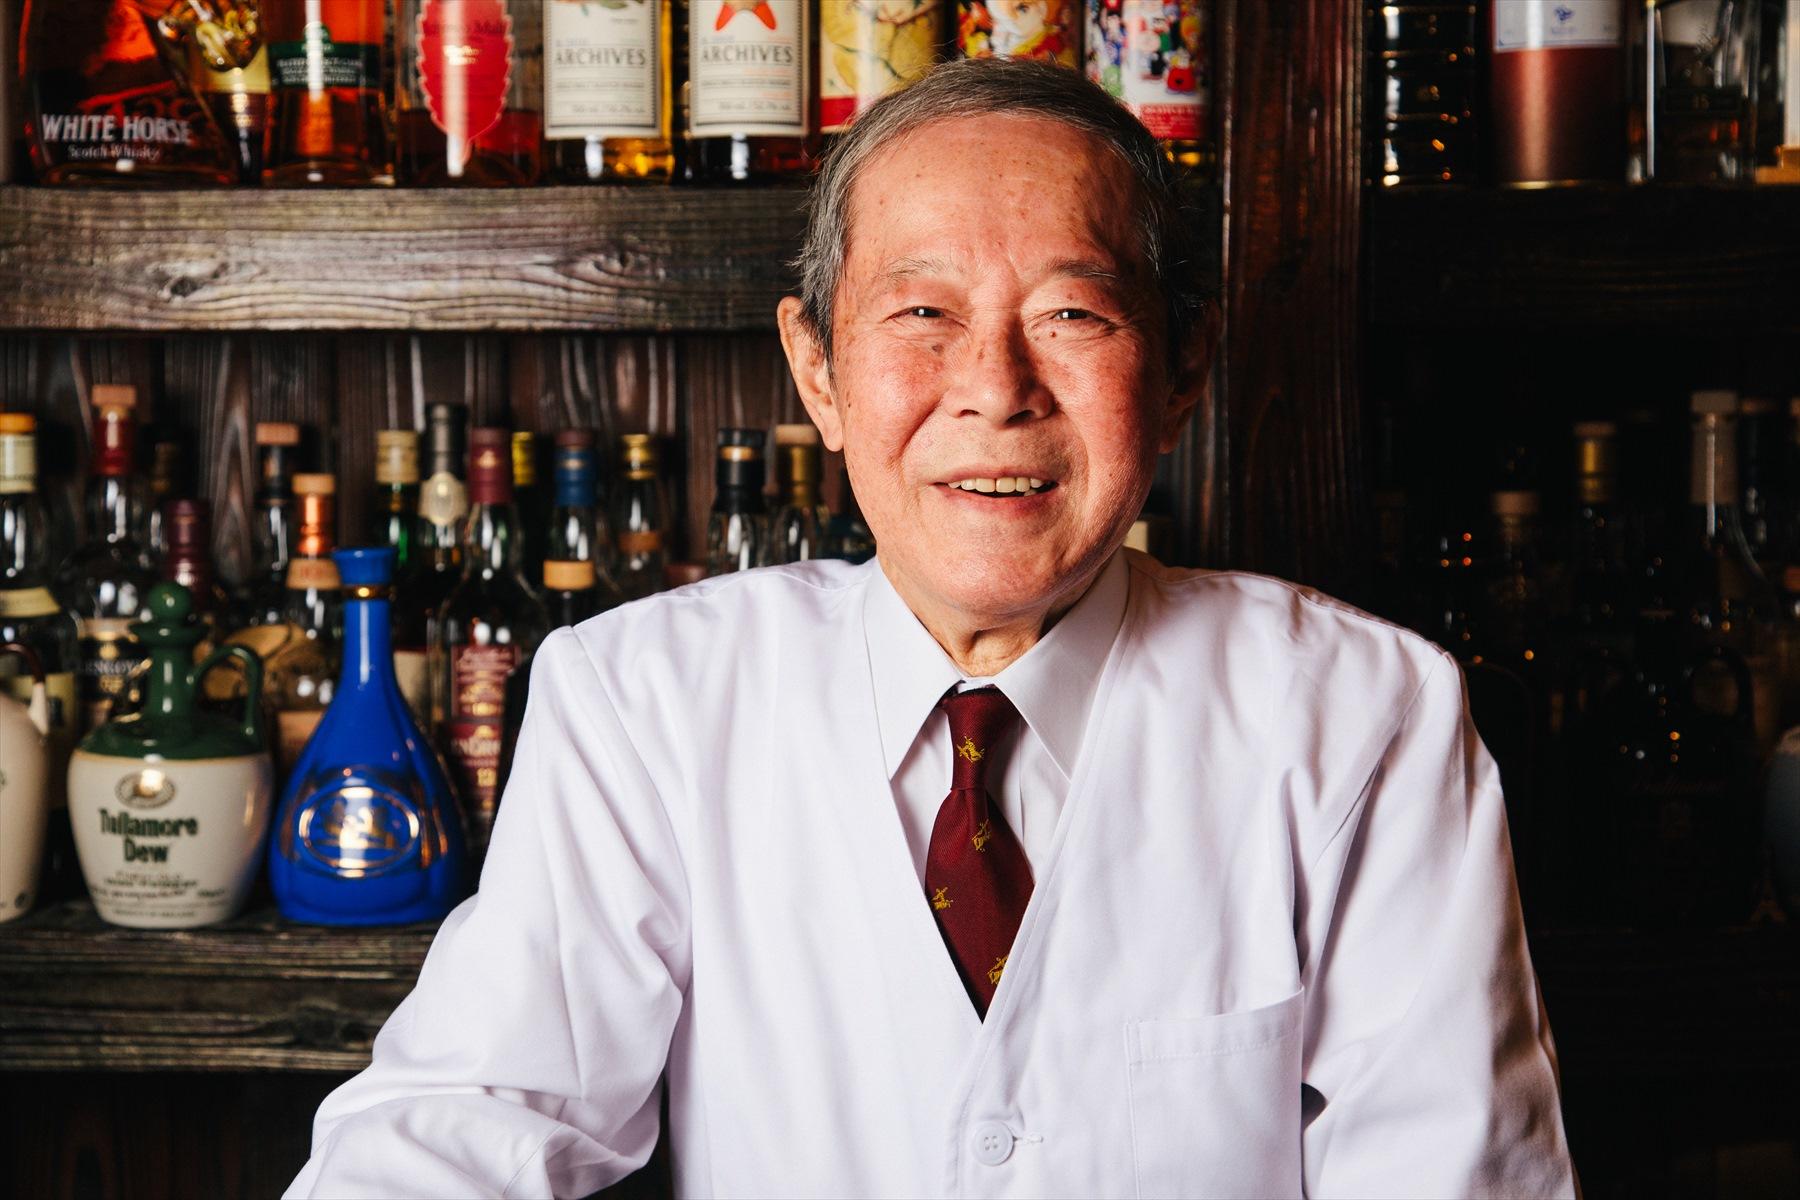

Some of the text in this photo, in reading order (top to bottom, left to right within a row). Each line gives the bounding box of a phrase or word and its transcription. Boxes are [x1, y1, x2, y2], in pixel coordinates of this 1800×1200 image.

[555, 48, 646, 65] ARCHIVES
[701, 45, 793, 63] ARCHIVES
[42, 113, 195, 145] WHITE HORSE
[69, 144, 161, 161] Scotch Whisky
[99, 808, 199, 837] Tullamore
[124, 838, 170, 863] Dew
